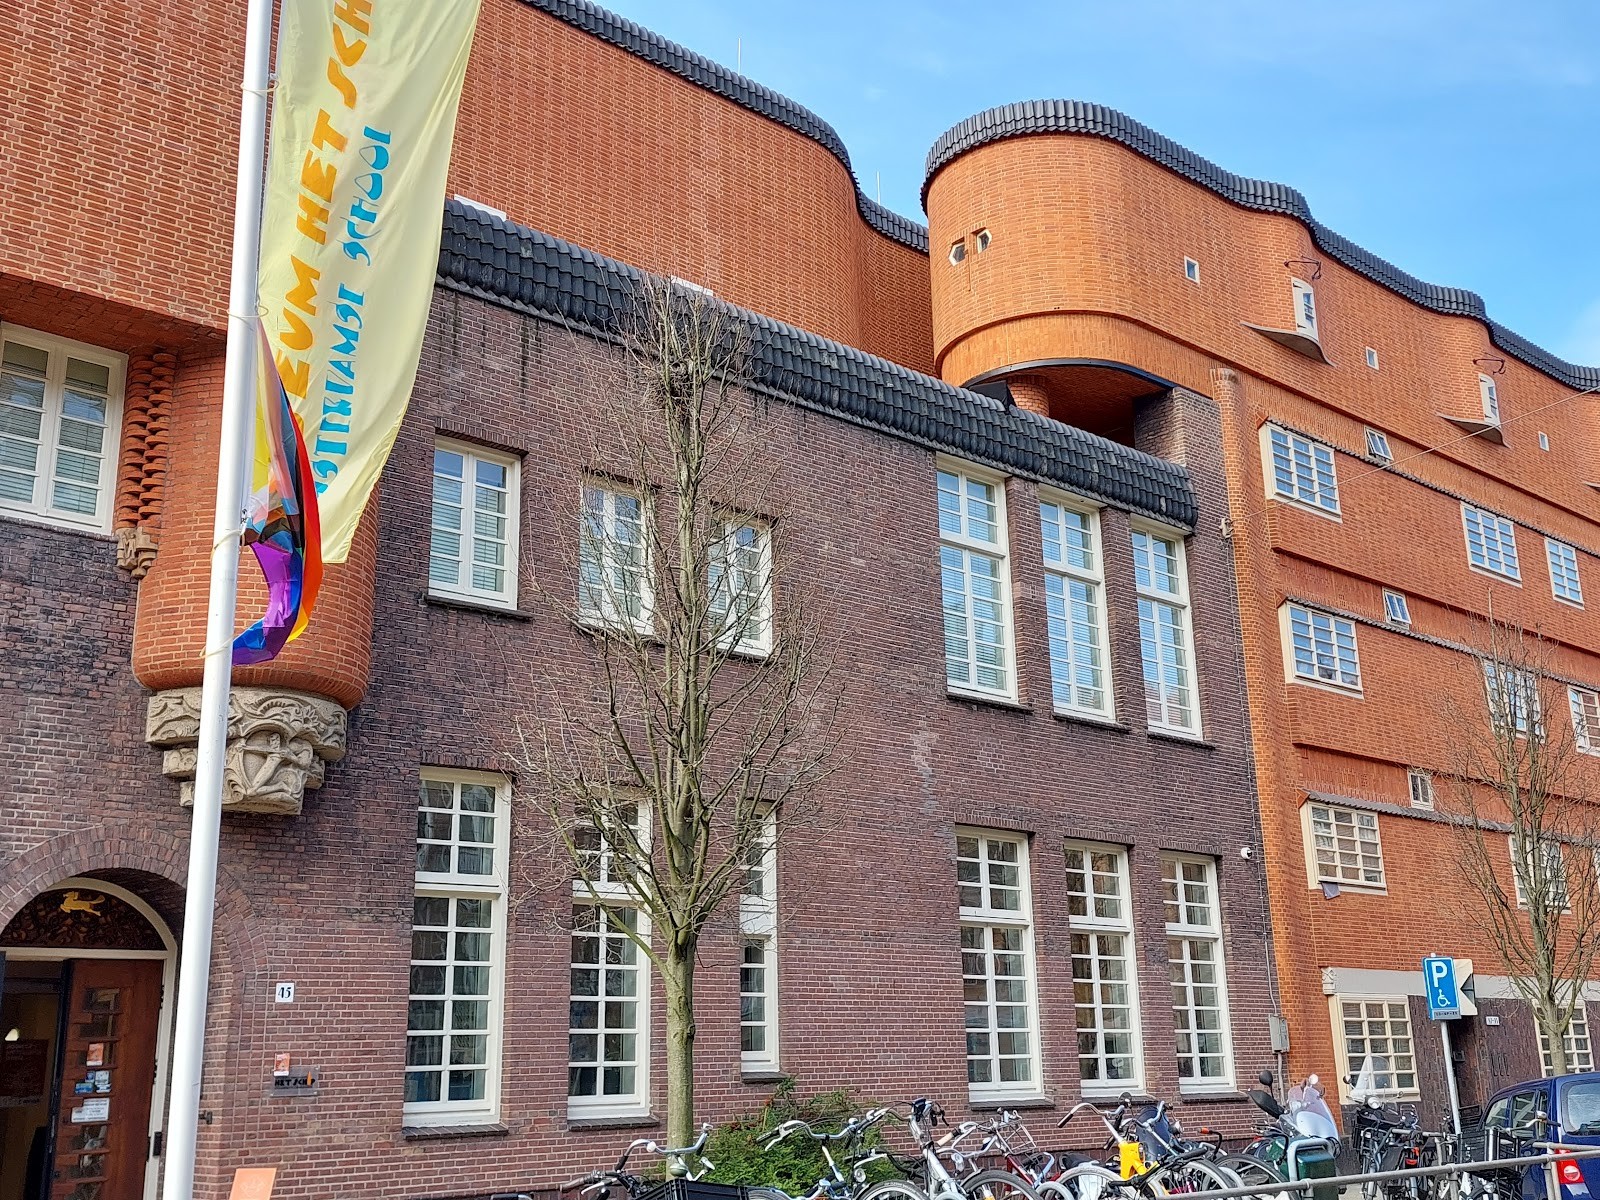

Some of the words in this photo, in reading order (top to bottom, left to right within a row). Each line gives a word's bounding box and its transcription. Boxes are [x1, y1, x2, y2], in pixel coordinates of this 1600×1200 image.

[296, 107, 349, 246] HET
[336, 126, 391, 266] SCHOOL
[1431, 961, 1448, 988] P
[278, 986, 292, 999] 45
[275, 1078, 292, 1087] HET
